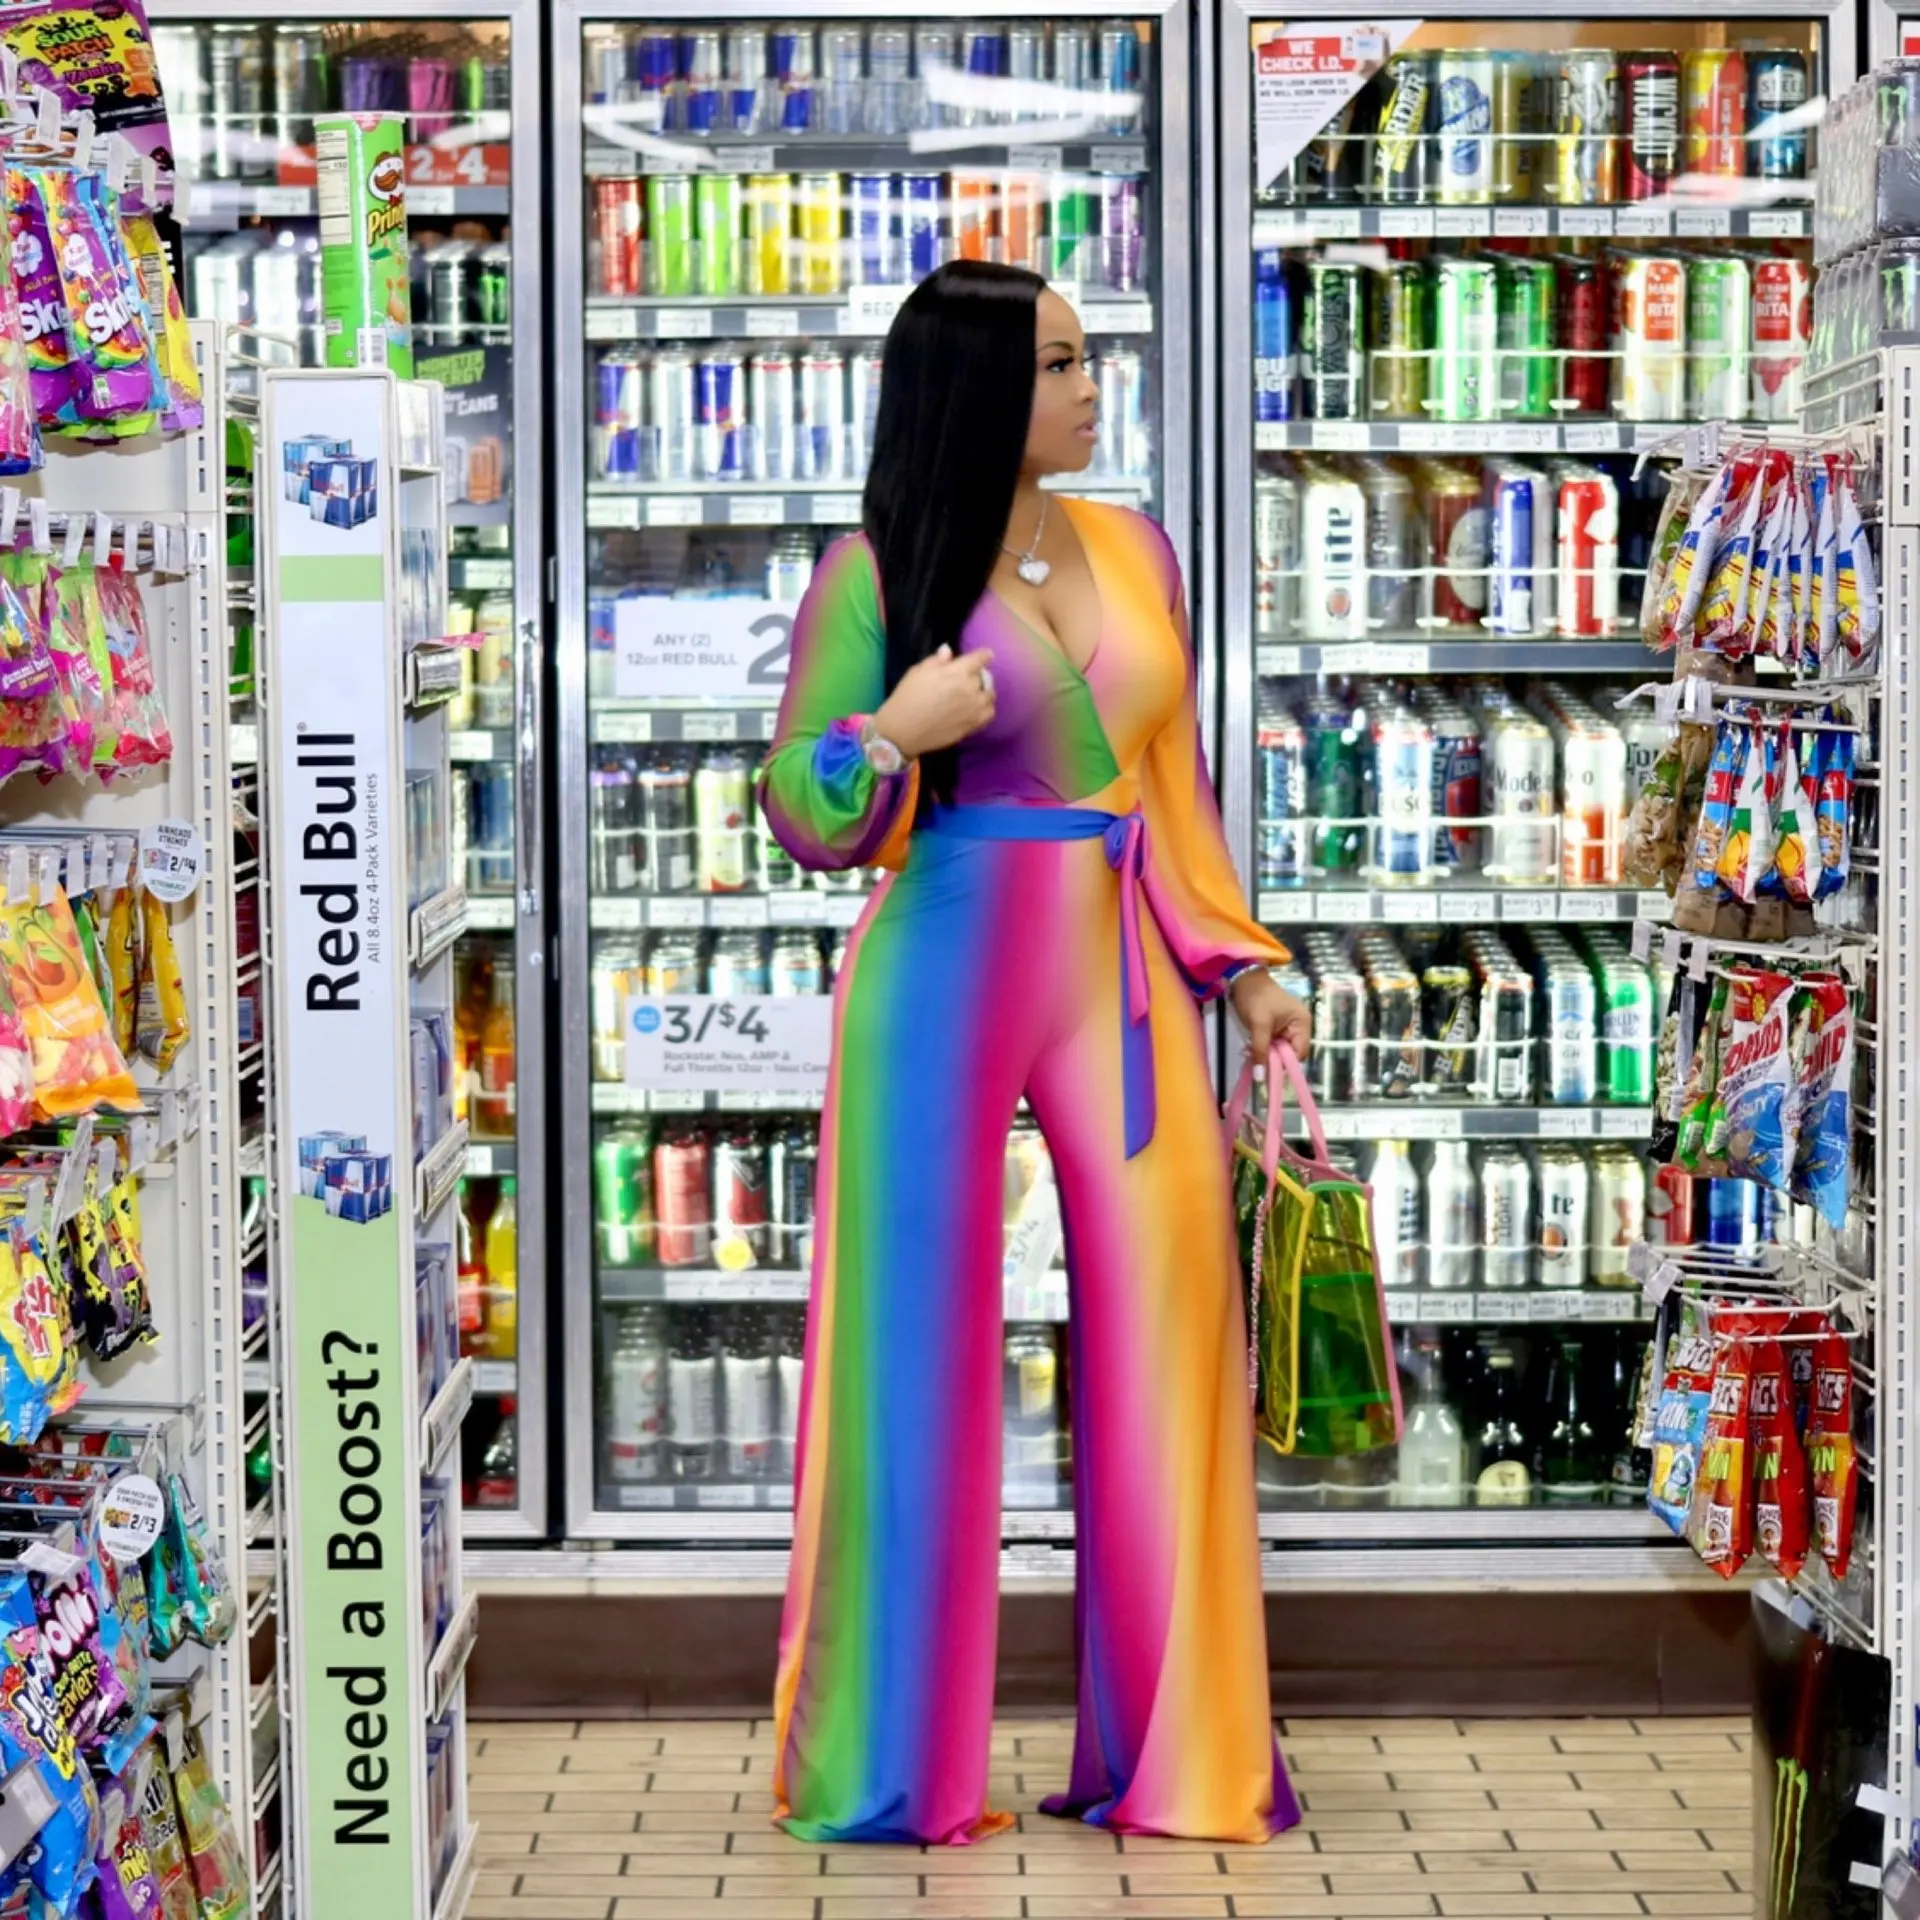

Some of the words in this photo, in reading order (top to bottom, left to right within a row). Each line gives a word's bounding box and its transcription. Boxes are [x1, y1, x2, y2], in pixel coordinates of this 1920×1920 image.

[36, 25, 99, 46] SOUR
[43, 34, 114, 60] PATCH
[1287, 40, 1317, 56] WE
[1261, 56, 1316, 73] CHECK
[1633, 77, 1678, 154] WICKED
[411, 148, 434, 181] 2
[1756, 302, 1789, 318] RITA
[653, 634, 687, 647] ANY
[691, 633, 711, 648] (2)
[662, 652, 695, 666] RED
[698, 653, 738, 666] BULL
[363, 773, 378, 840] Varieties
[365, 845, 379, 893] 4-Pack
[366, 897, 380, 939] 8.4oz
[299, 884, 361, 1011] Red
[366, 942, 380, 963] All
[663, 1001, 769, 1044] 3/$4
[750, 1051, 778, 1061] AMP
[1723, 1014, 1782, 1077] DAVID
[663, 1062, 684, 1073] Full
[688, 1062, 734, 1073] Throttle
[321, 1330, 382, 1570] Boost?
[342, 1601, 385, 1638] a
[326, 1666, 390, 1845] Need
